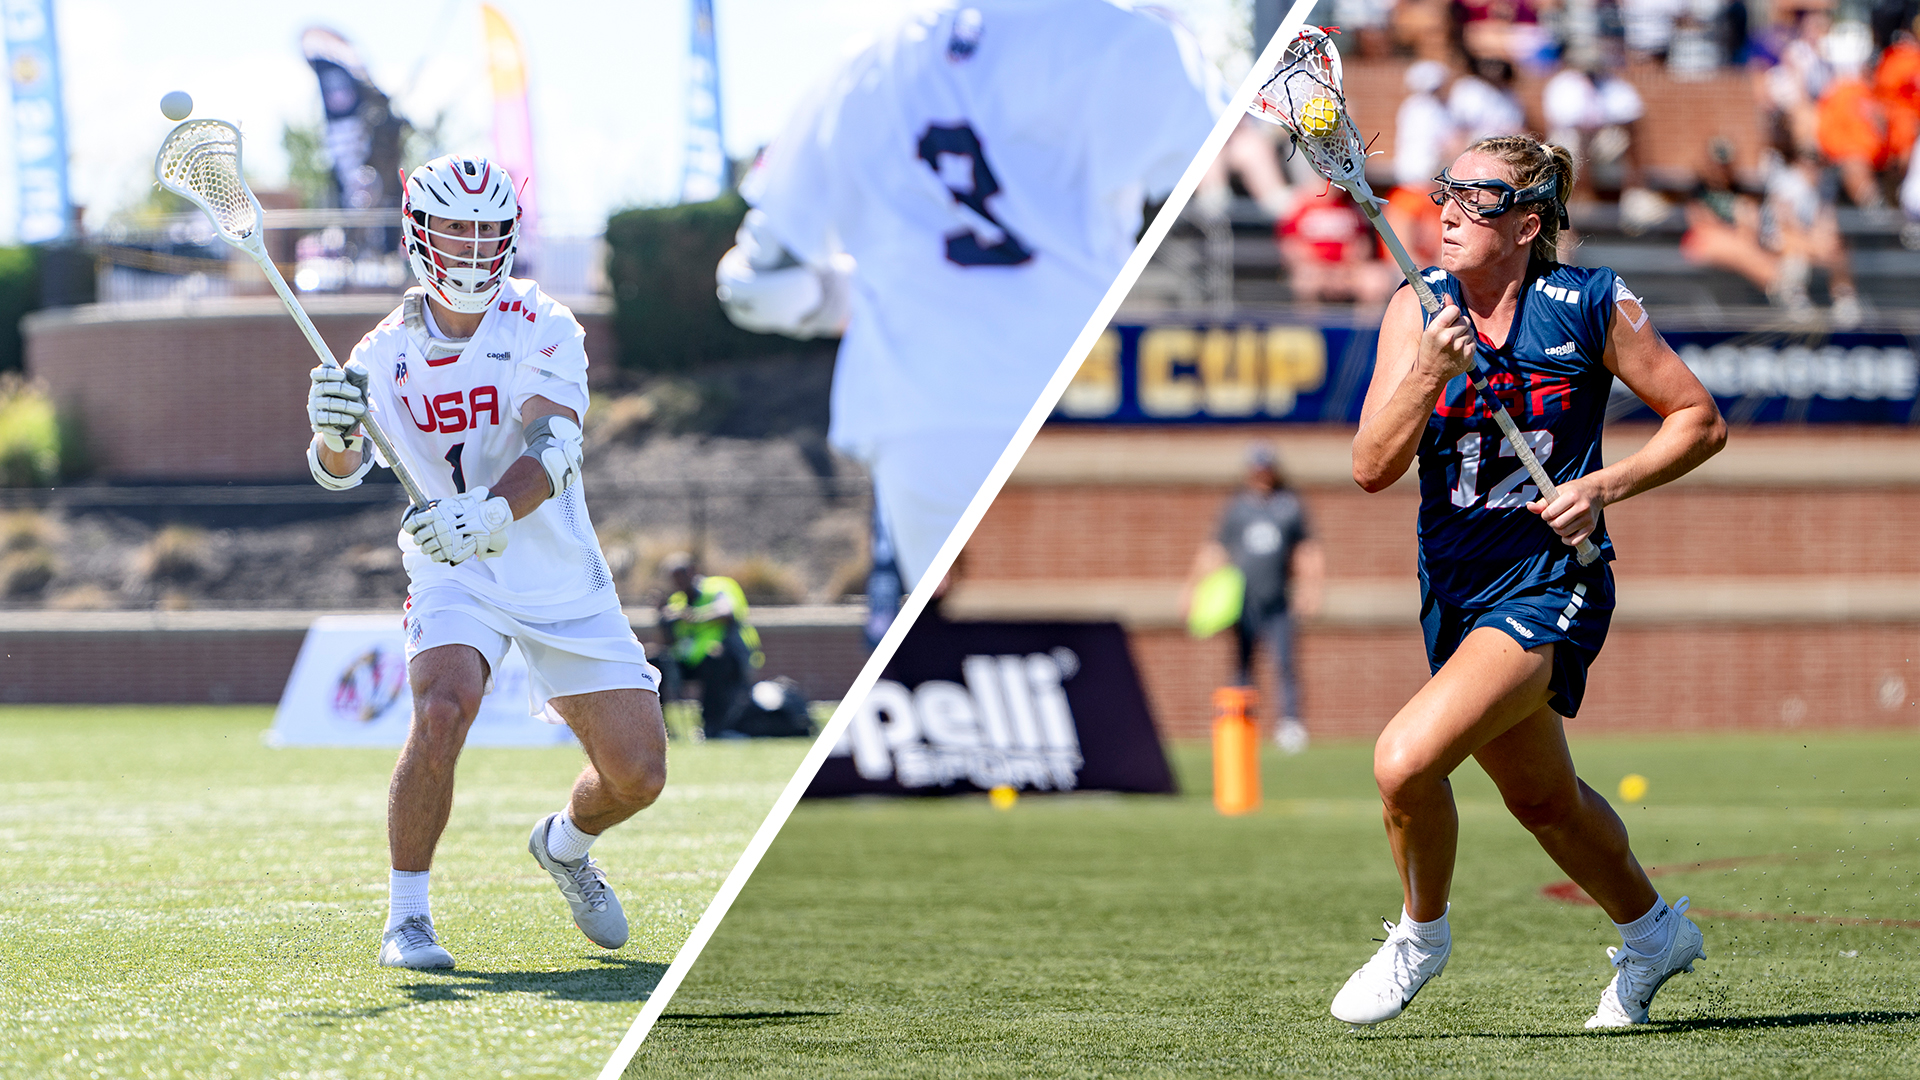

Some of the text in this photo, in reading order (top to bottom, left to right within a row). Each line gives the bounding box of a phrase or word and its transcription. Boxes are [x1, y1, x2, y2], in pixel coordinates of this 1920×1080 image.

[1538, 179, 1555, 194] GAIT
[486, 351, 511, 360] capelli
[1137, 325, 1328, 418] CUP
[1545, 341, 1576, 356] capelli
[401, 385, 500, 434] USA
[1435, 372, 1571, 419] USA
[444, 442, 467, 495] 1
[1451, 429, 1554, 510] 12
[828, 652, 1081, 781] pelli
